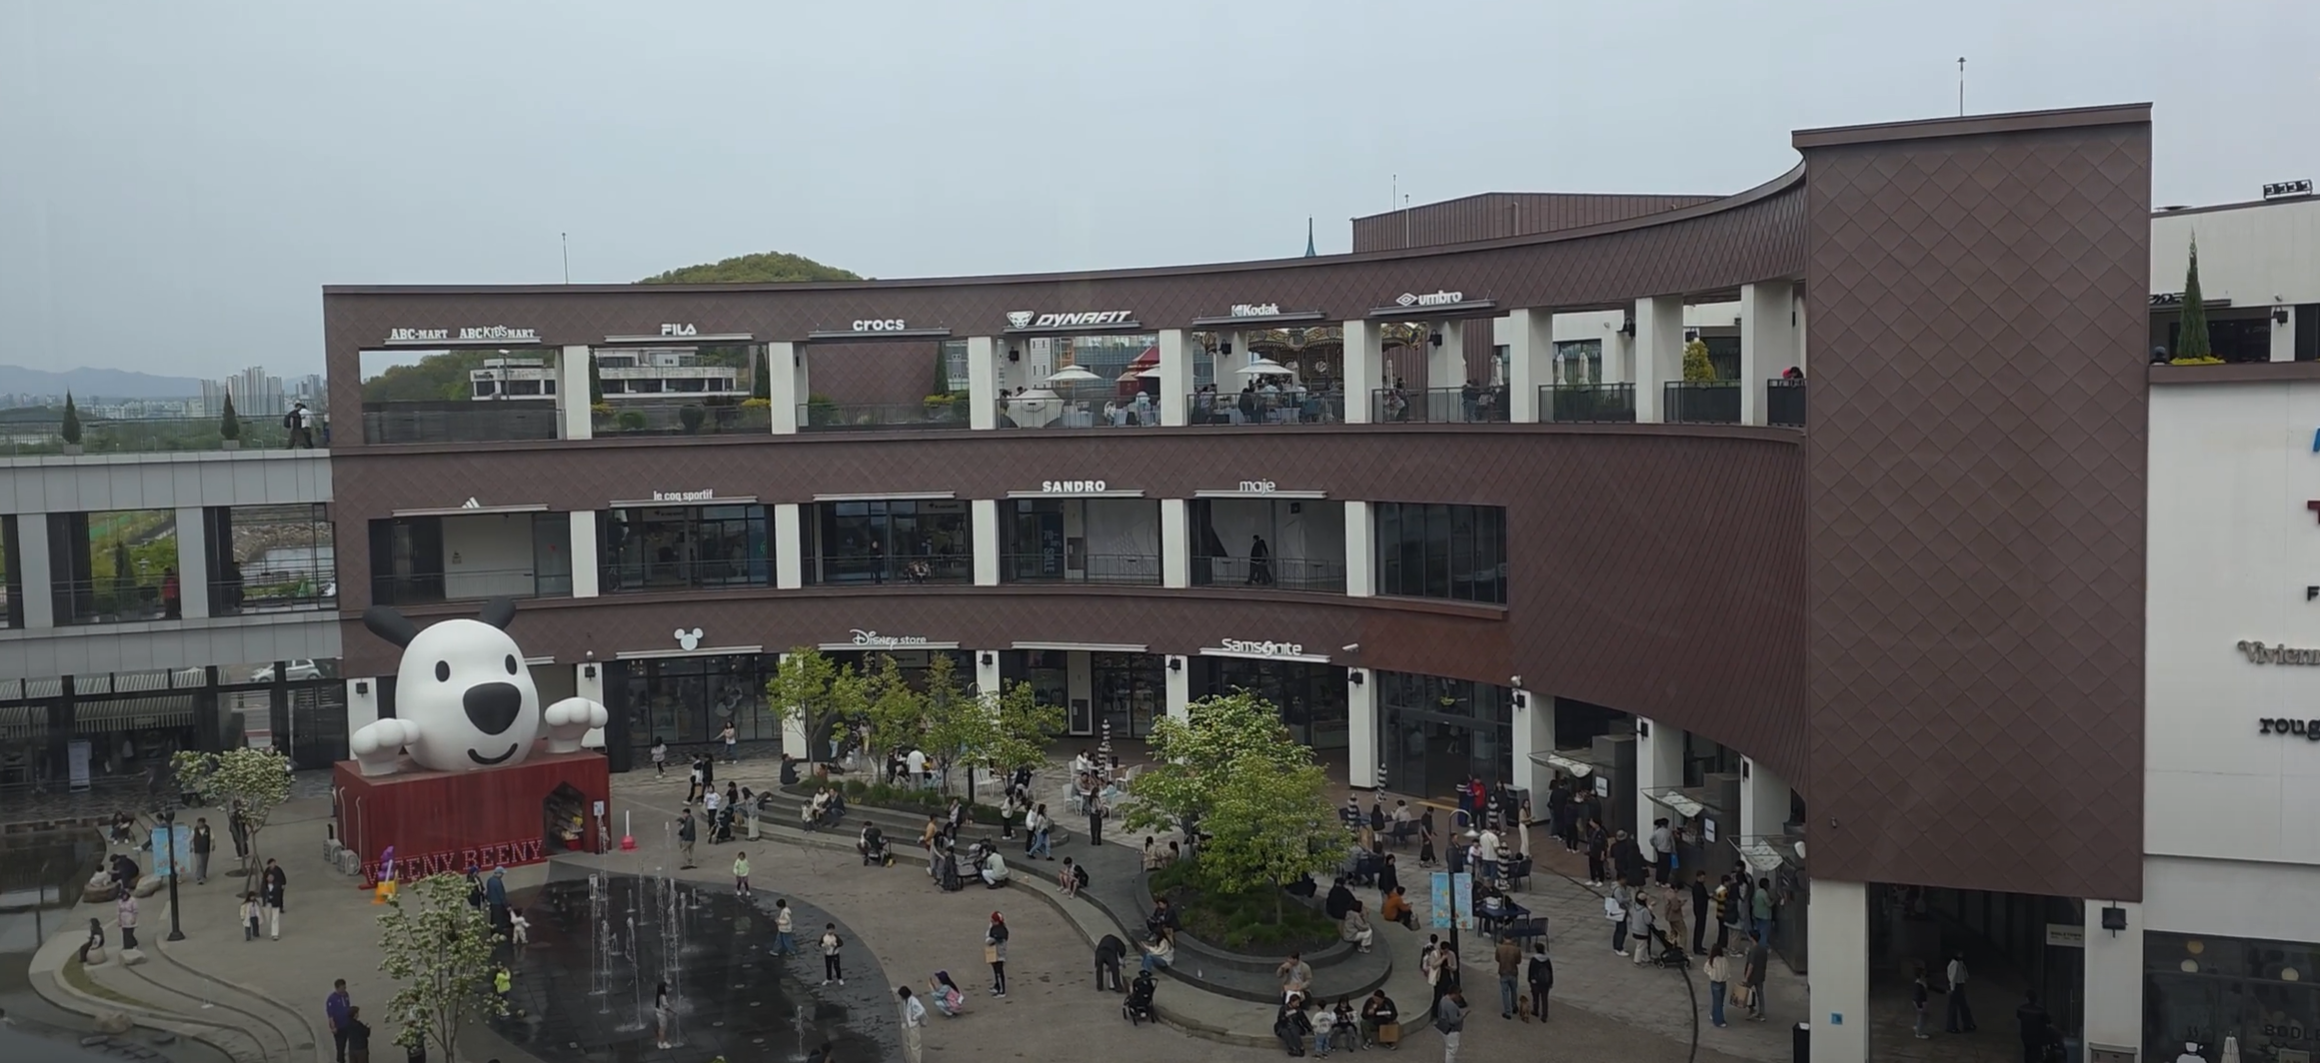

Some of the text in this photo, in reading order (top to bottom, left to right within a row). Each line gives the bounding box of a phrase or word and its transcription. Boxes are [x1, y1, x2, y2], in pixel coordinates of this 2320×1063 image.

[1418, 290, 1463, 306] umbro
[1243, 303, 1280, 317] Kodak
[852, 319, 905, 331] crocs
[1035, 310, 1132, 328] DYNAFIT
[391, 328, 449, 340] ABC-MART
[661, 323, 697, 336] FILA
[1042, 480, 1106, 493] SANDRO
[1239, 478, 1276, 496] maje
[653, 488, 713, 502] le coq sportif
[849, 629, 927, 650] Disney store
[1221, 638, 1303, 657] Samsonite
[462, 839, 544, 871] BEENY
